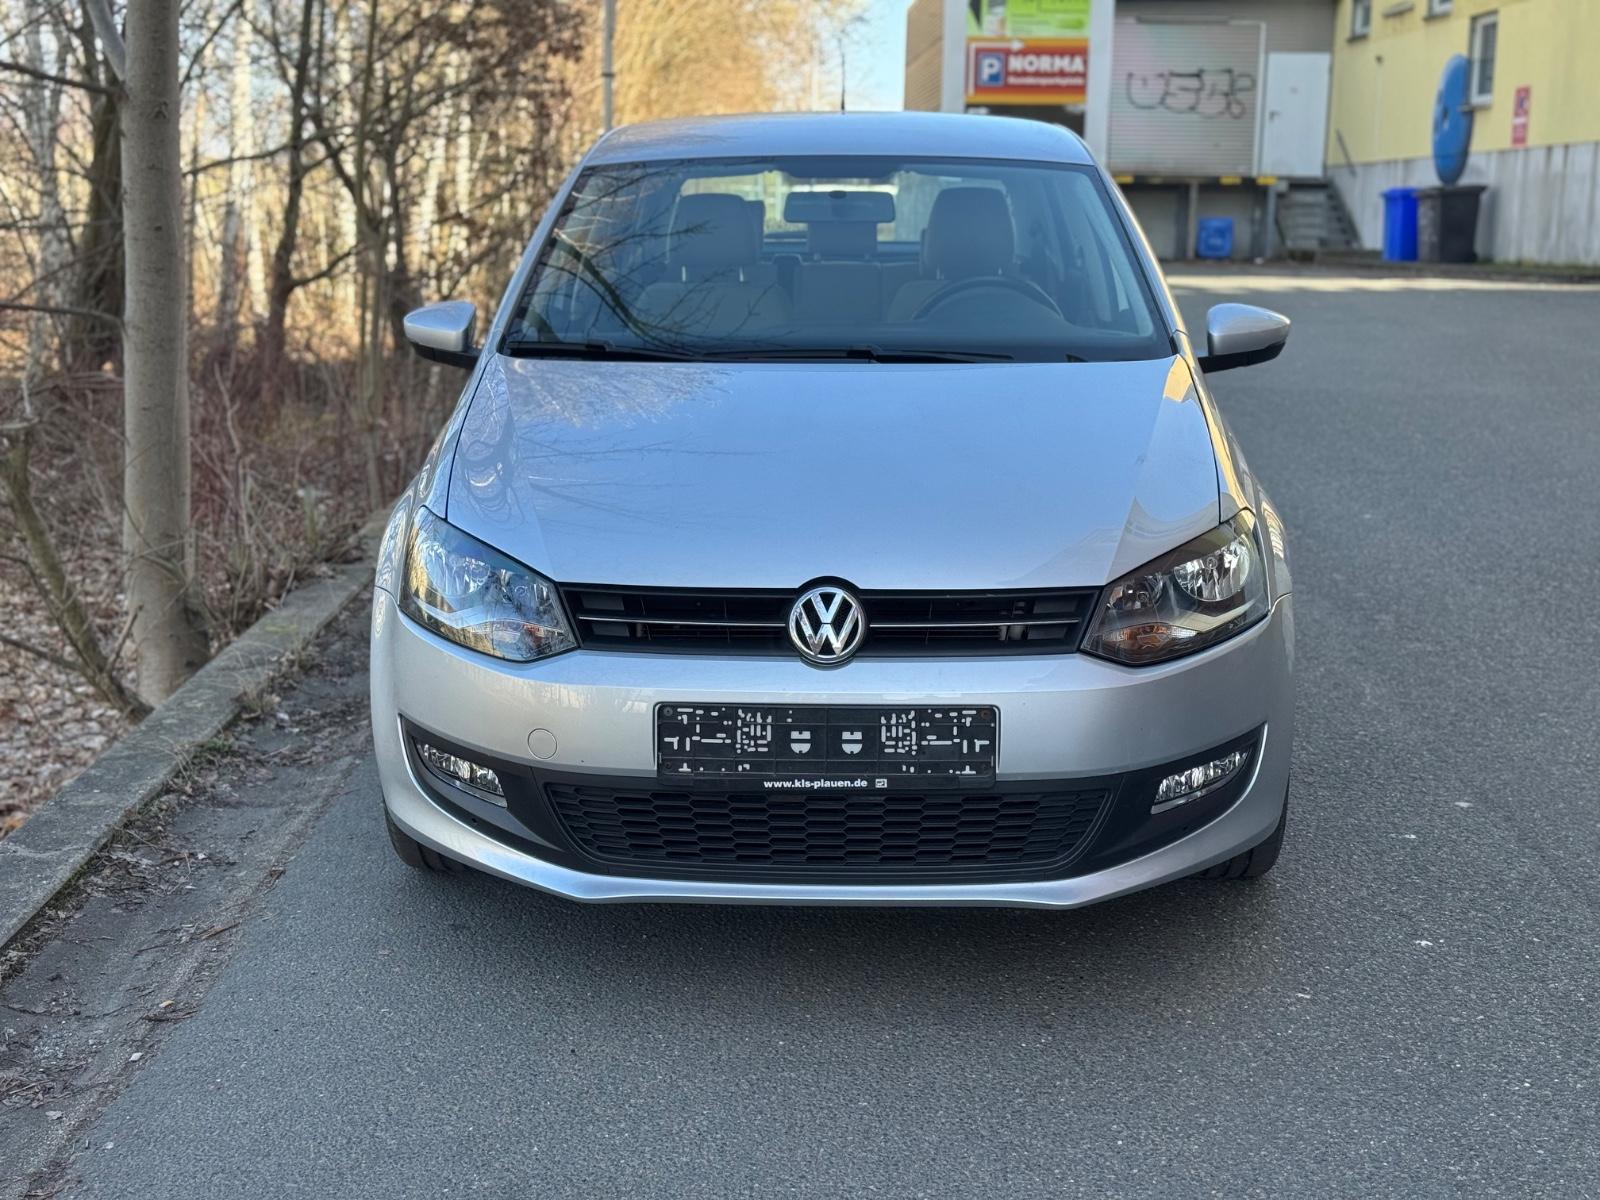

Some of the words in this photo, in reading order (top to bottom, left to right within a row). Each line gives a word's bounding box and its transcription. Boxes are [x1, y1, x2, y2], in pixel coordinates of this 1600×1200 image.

[982, 57, 1001, 82] P
[1008, 54, 1085, 73] NORMA
[792, 589, 862, 658] VW
[763, 778, 868, 790] www.kls-plauen.de
